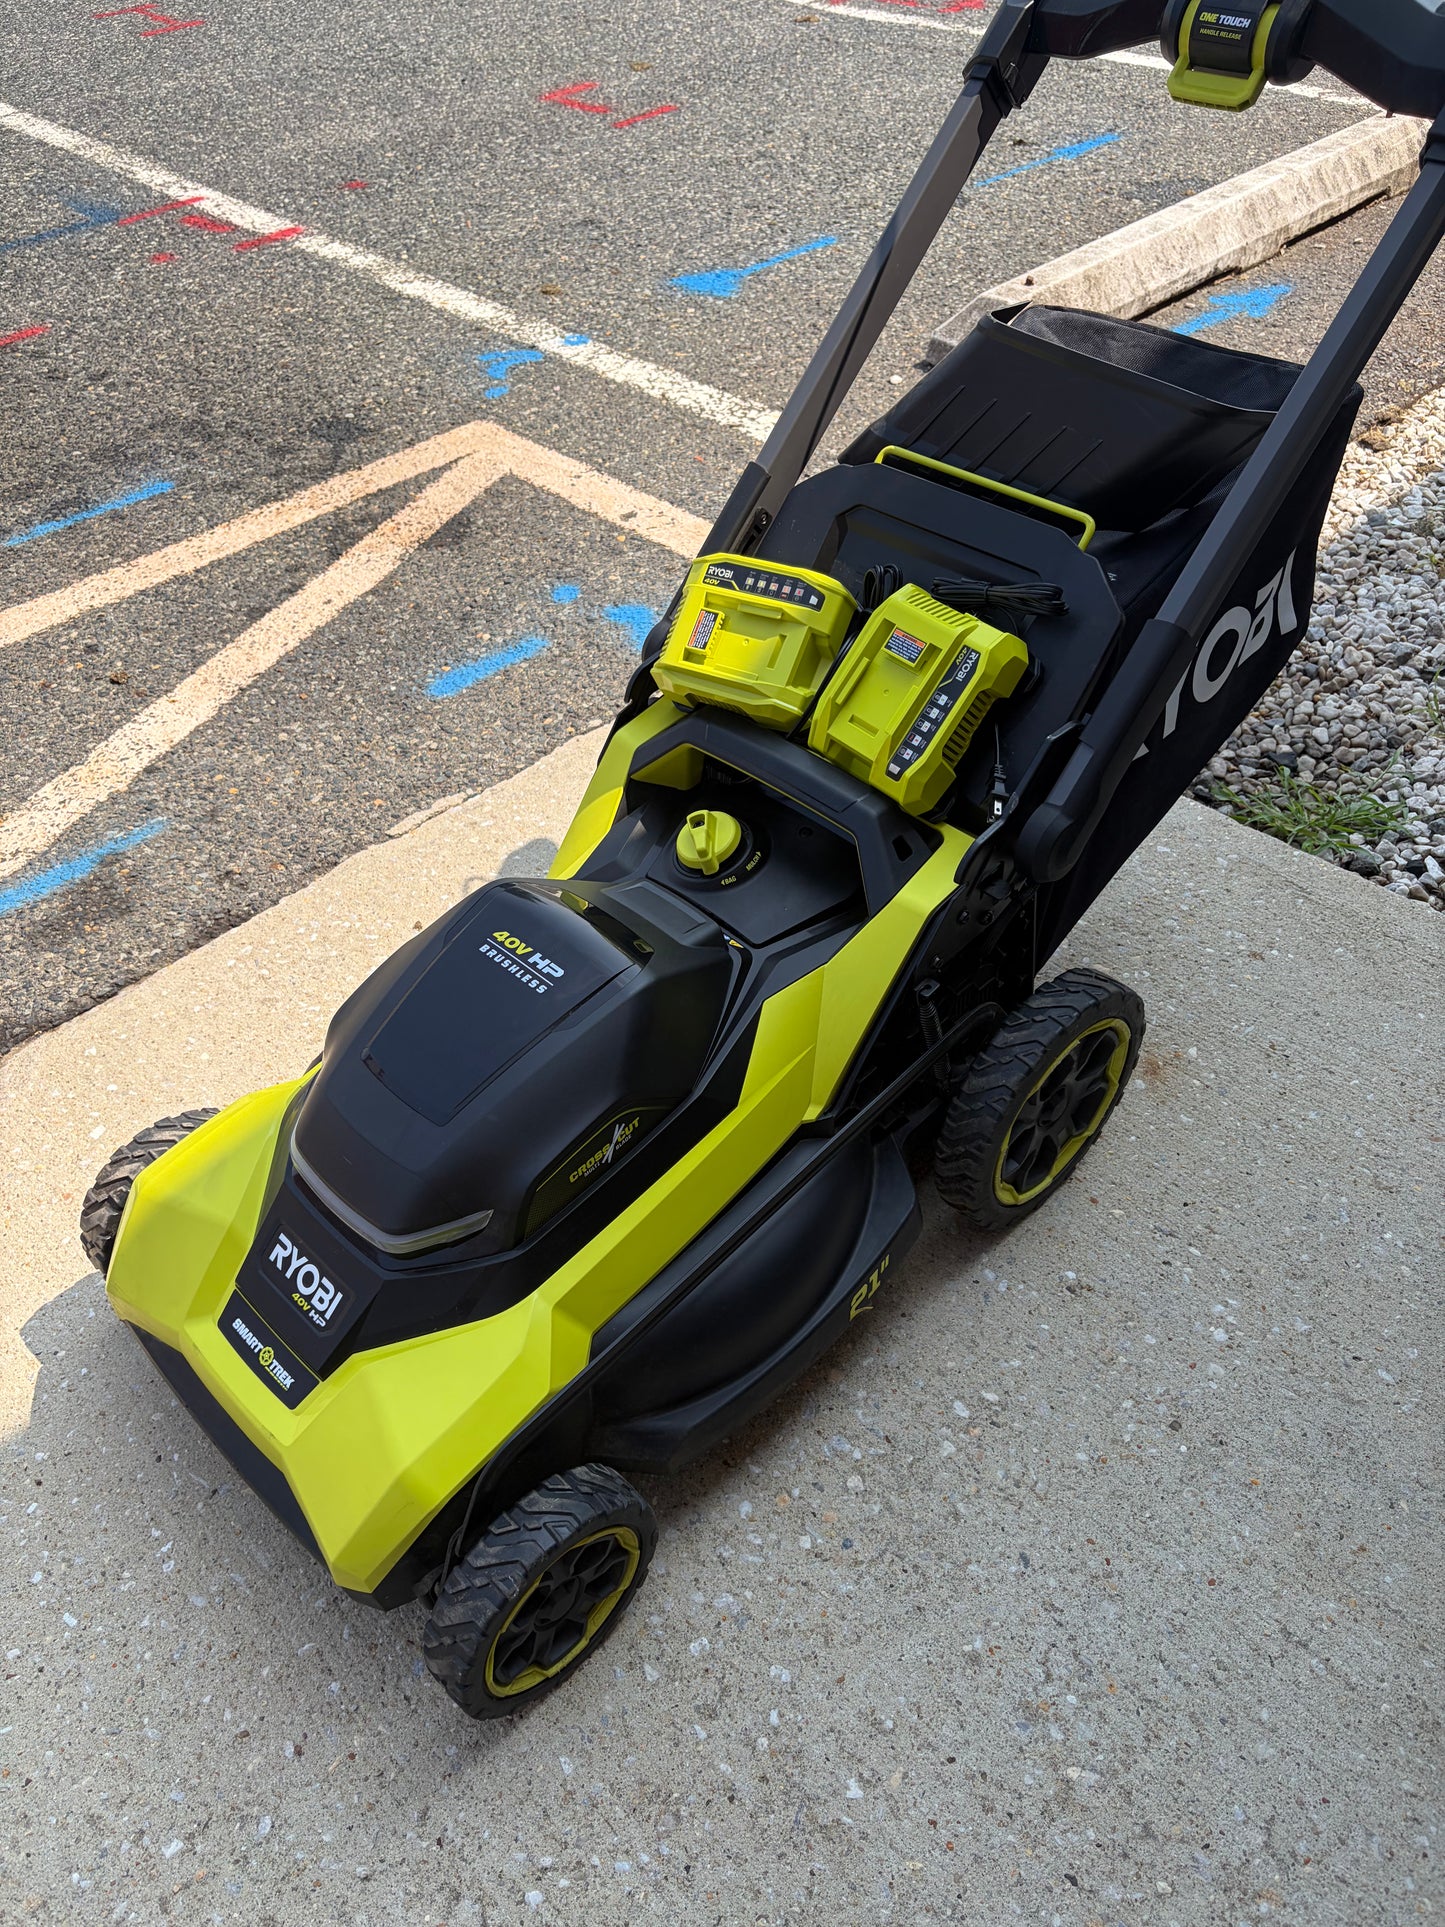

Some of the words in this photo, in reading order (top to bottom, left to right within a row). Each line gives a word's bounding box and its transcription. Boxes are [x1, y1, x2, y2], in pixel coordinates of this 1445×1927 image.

[1199, 11, 1219, 22] ONE
[1219, 14, 1251, 28] TOUCH
[1199, 28, 1220, 36] HANDLE
[1219, 31, 1242, 40] RELEASE
[704, 578, 721, 586] 40V
[707, 566, 734, 579] RYOBI
[956, 652, 979, 682] RYOBI
[724, 875, 737, 885] BAG
[478, 943, 548, 994] BRUSHLESS
[492, 931, 534, 955] 40V
[527, 952, 565, 978] HP
[268, 1232, 344, 1321] RYOBI
[291, 1293, 311, 1312] 40V
[308, 1309, 327, 1328] HP
[231, 1317, 264, 1353] SMART
[269, 1358, 295, 1390] TREK
